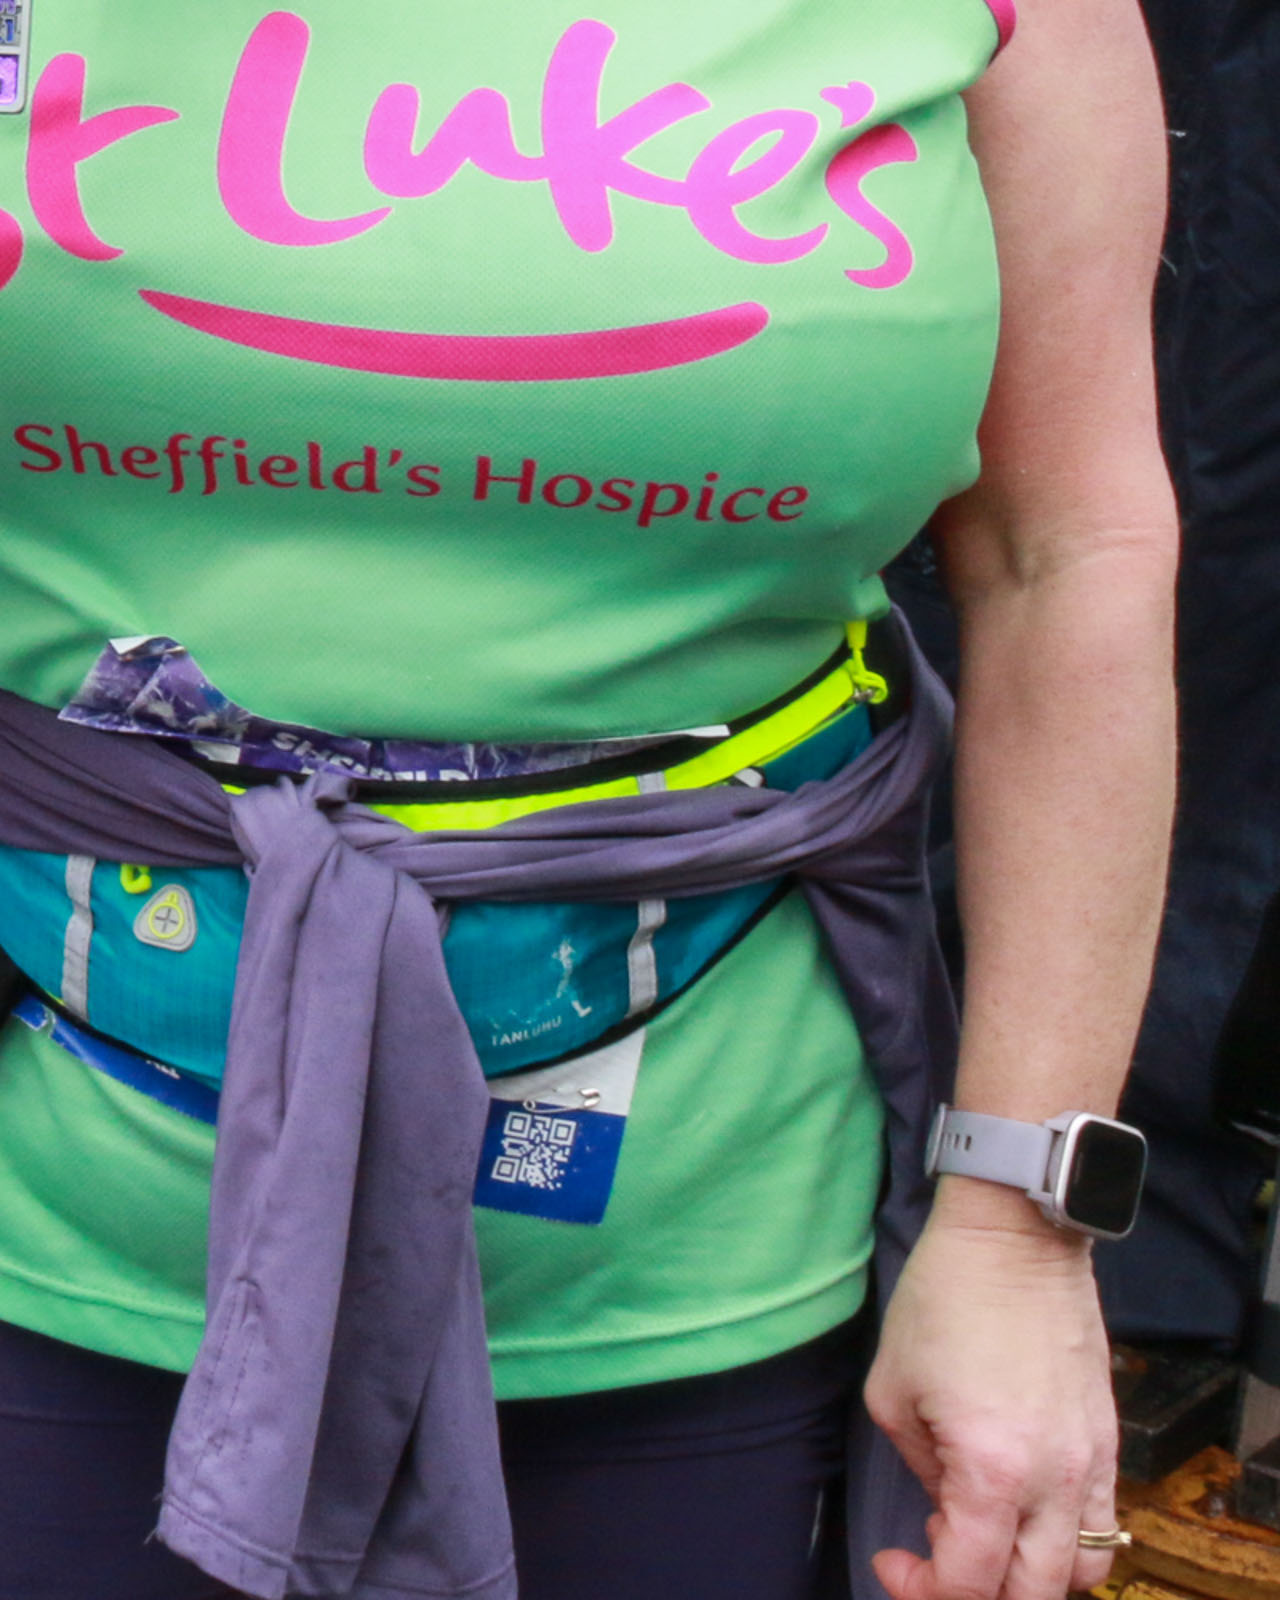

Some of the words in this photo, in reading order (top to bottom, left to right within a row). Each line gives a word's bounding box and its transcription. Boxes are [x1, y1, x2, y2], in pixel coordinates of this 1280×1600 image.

[216, 9, 919, 290] Luke's
[12, 423, 443, 498] Sheffield's
[472, 456, 810, 529] Hospice
